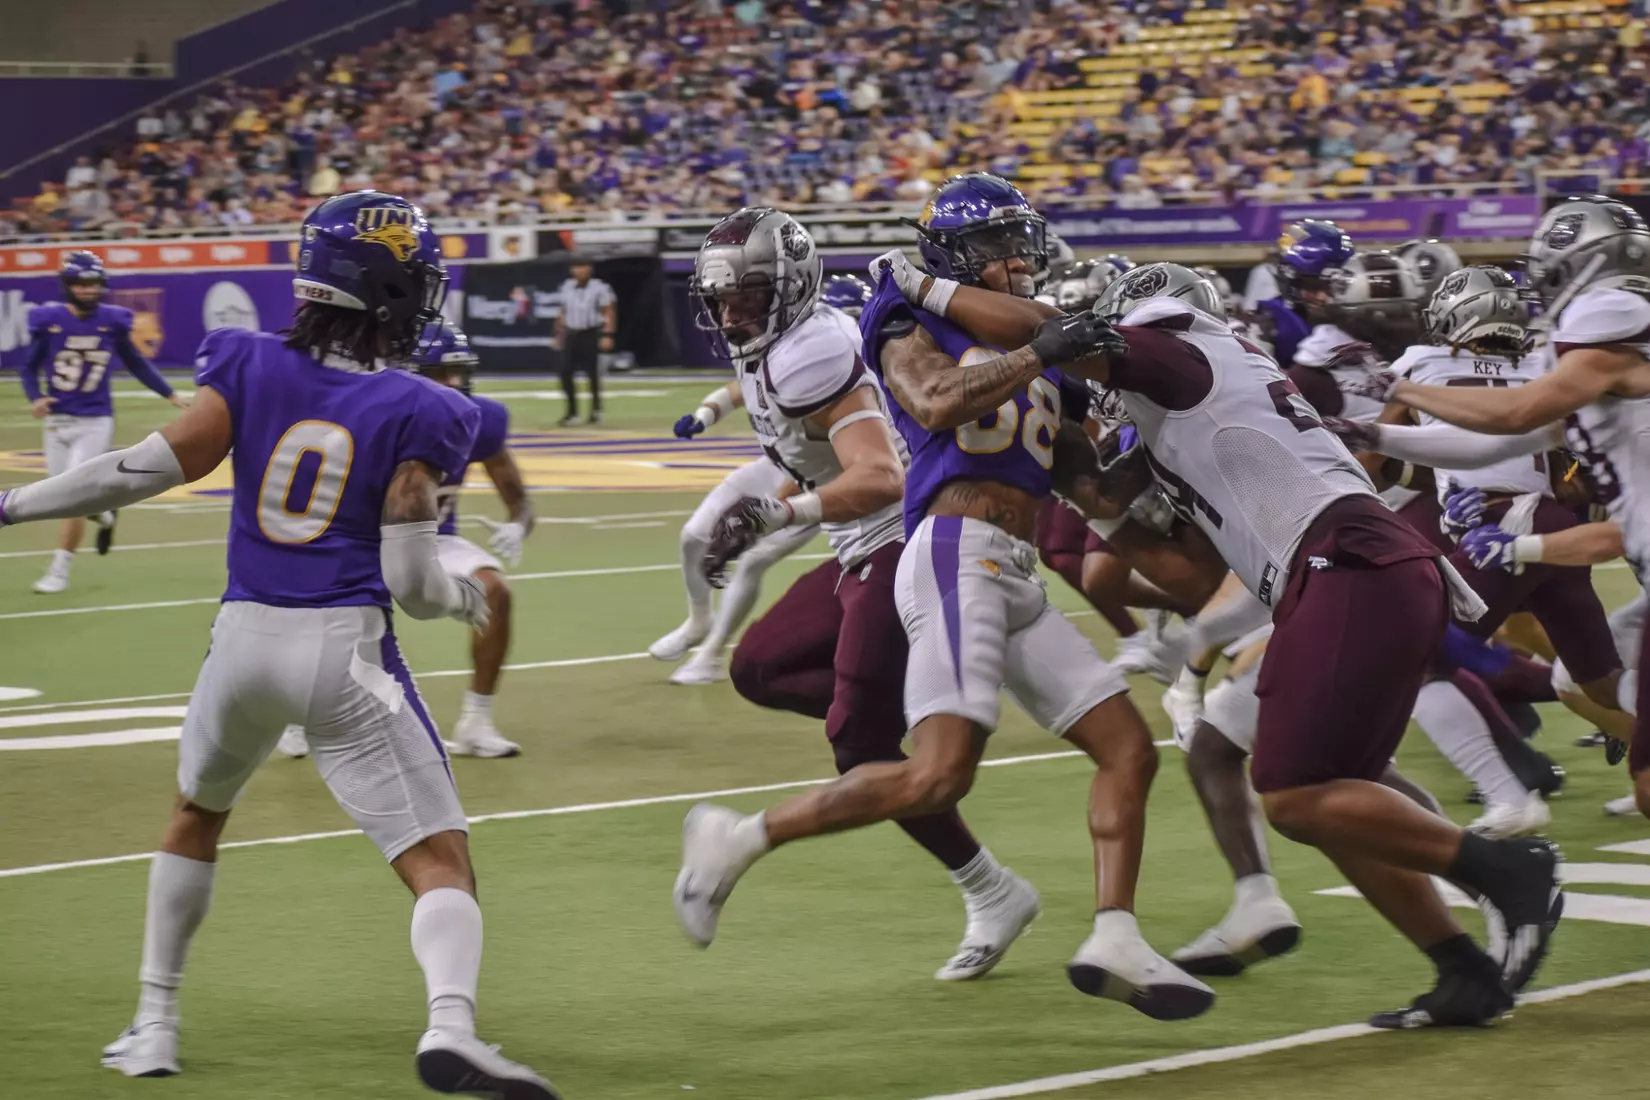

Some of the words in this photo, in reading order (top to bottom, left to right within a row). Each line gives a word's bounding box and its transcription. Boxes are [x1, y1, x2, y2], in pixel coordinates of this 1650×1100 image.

[51, 350, 112, 392] 97
[1473, 360, 1502, 376] KEY
[257, 419, 354, 544] 0
